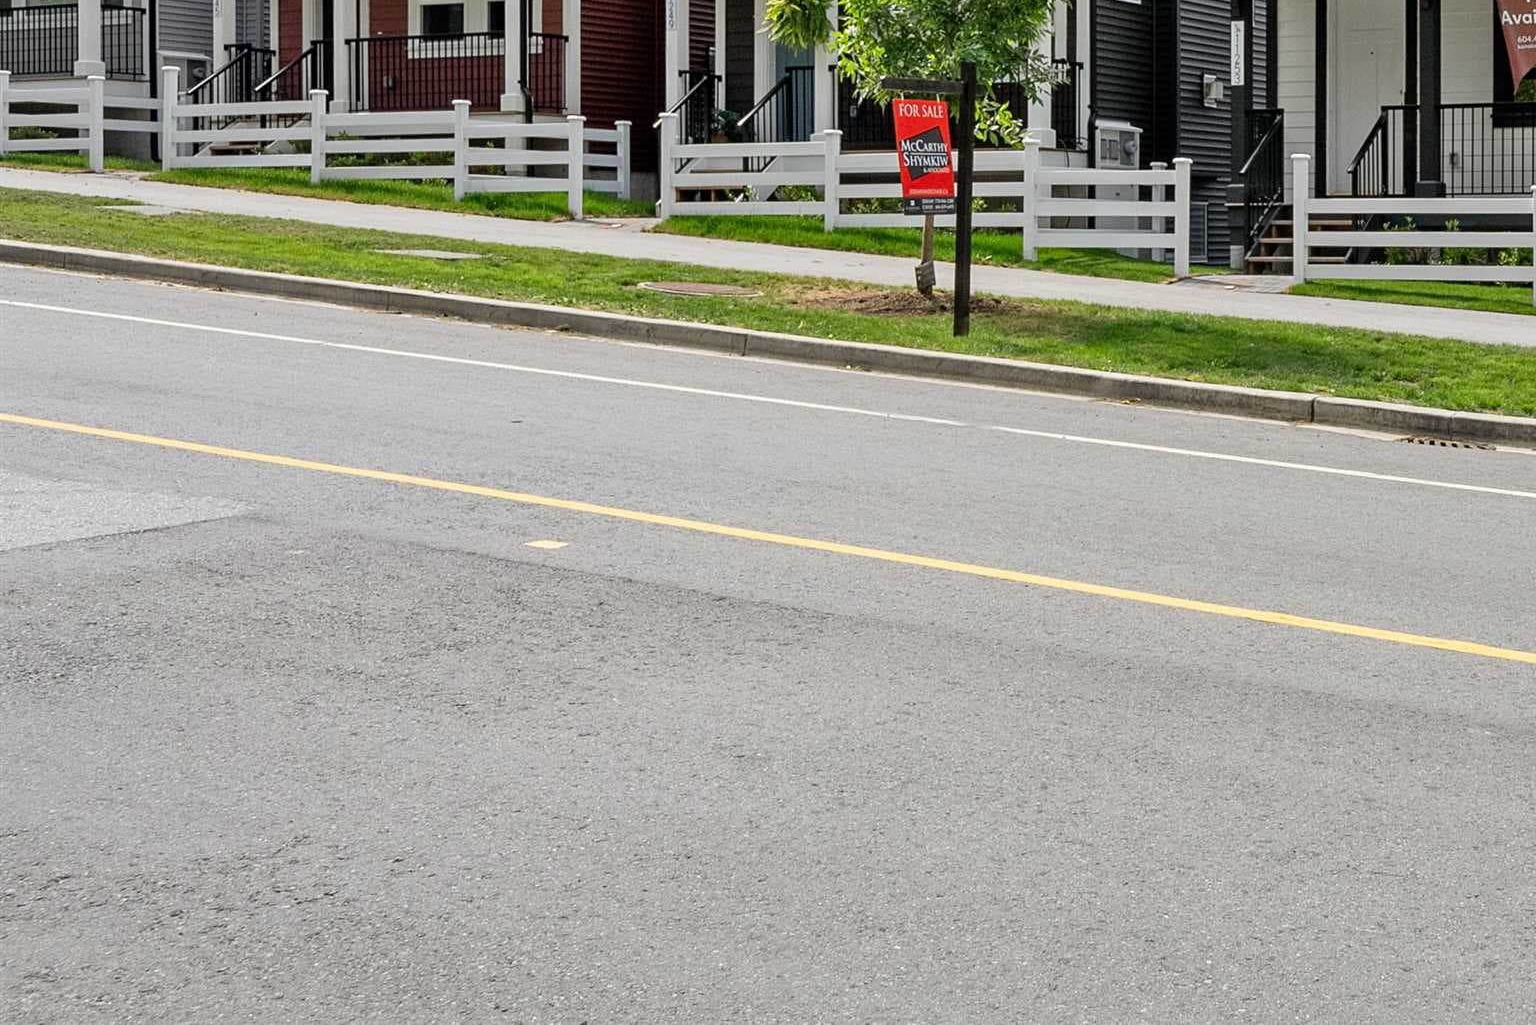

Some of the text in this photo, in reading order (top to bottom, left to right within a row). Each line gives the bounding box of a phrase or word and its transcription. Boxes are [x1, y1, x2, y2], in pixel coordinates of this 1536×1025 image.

[900, 104, 944, 118] FOR SALE
[903, 152, 948, 167] SHYMKIW
